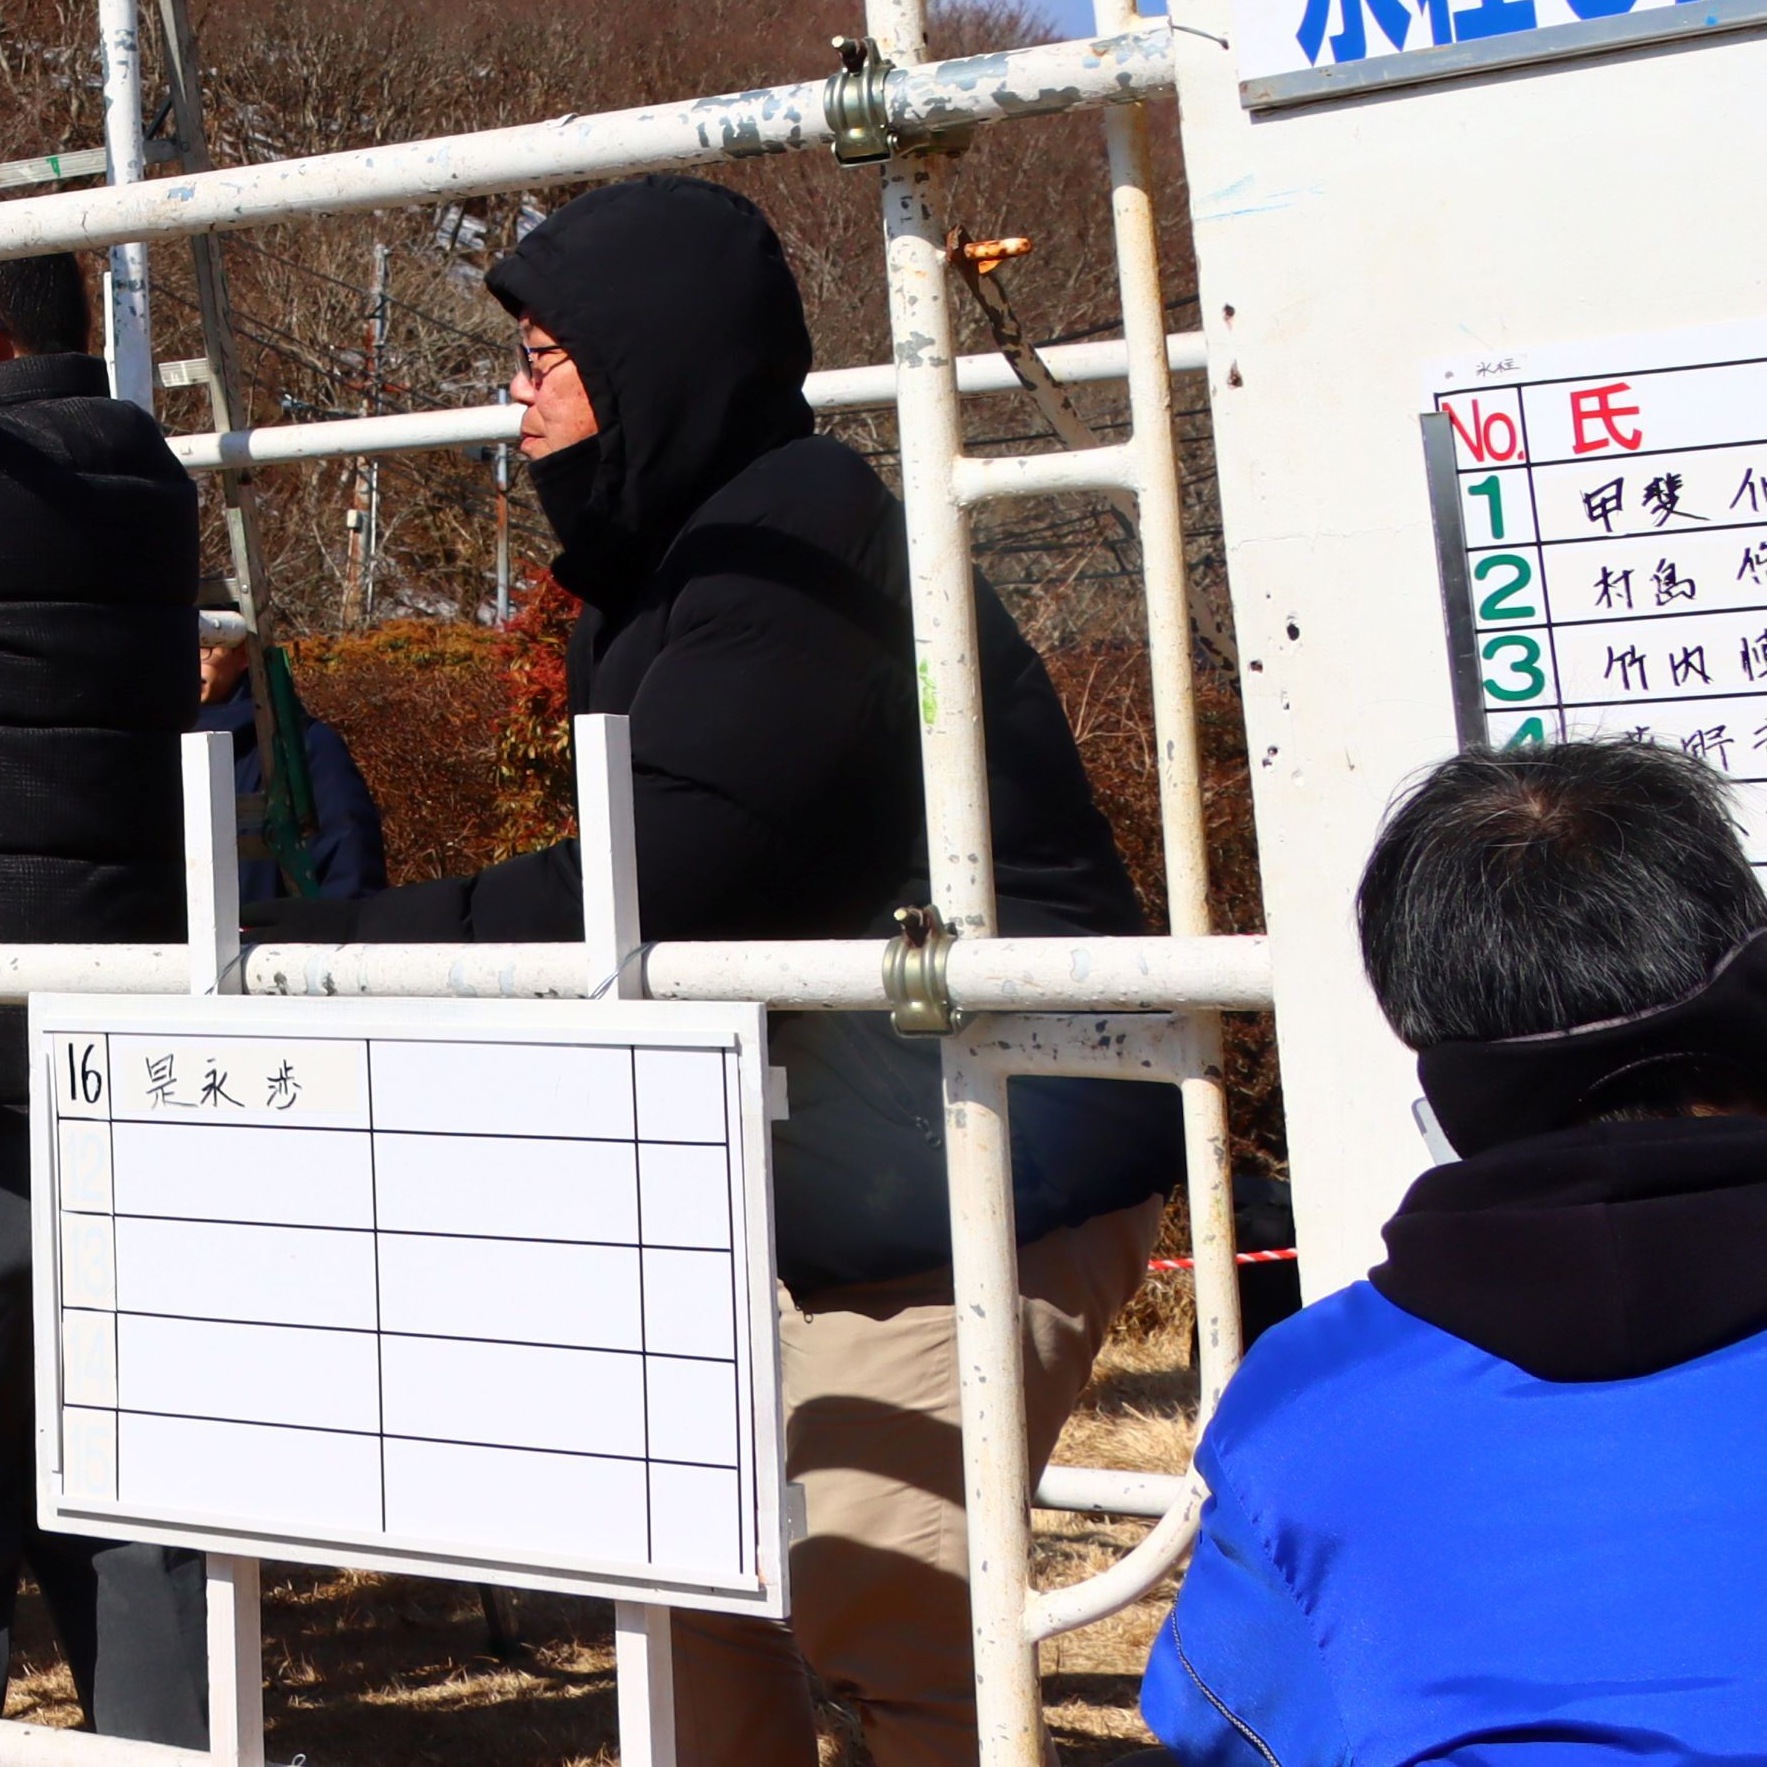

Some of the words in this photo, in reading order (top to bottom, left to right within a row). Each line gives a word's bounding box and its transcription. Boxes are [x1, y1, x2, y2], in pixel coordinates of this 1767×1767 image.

[1441, 398, 1525, 463] No.
[1569, 381, 1644, 455] 氏
[1467, 474, 1505, 540] 1
[1473, 554, 1536, 621] 2
[1481, 634, 1546, 702] 3
[68, 1042, 103, 1105] 16
